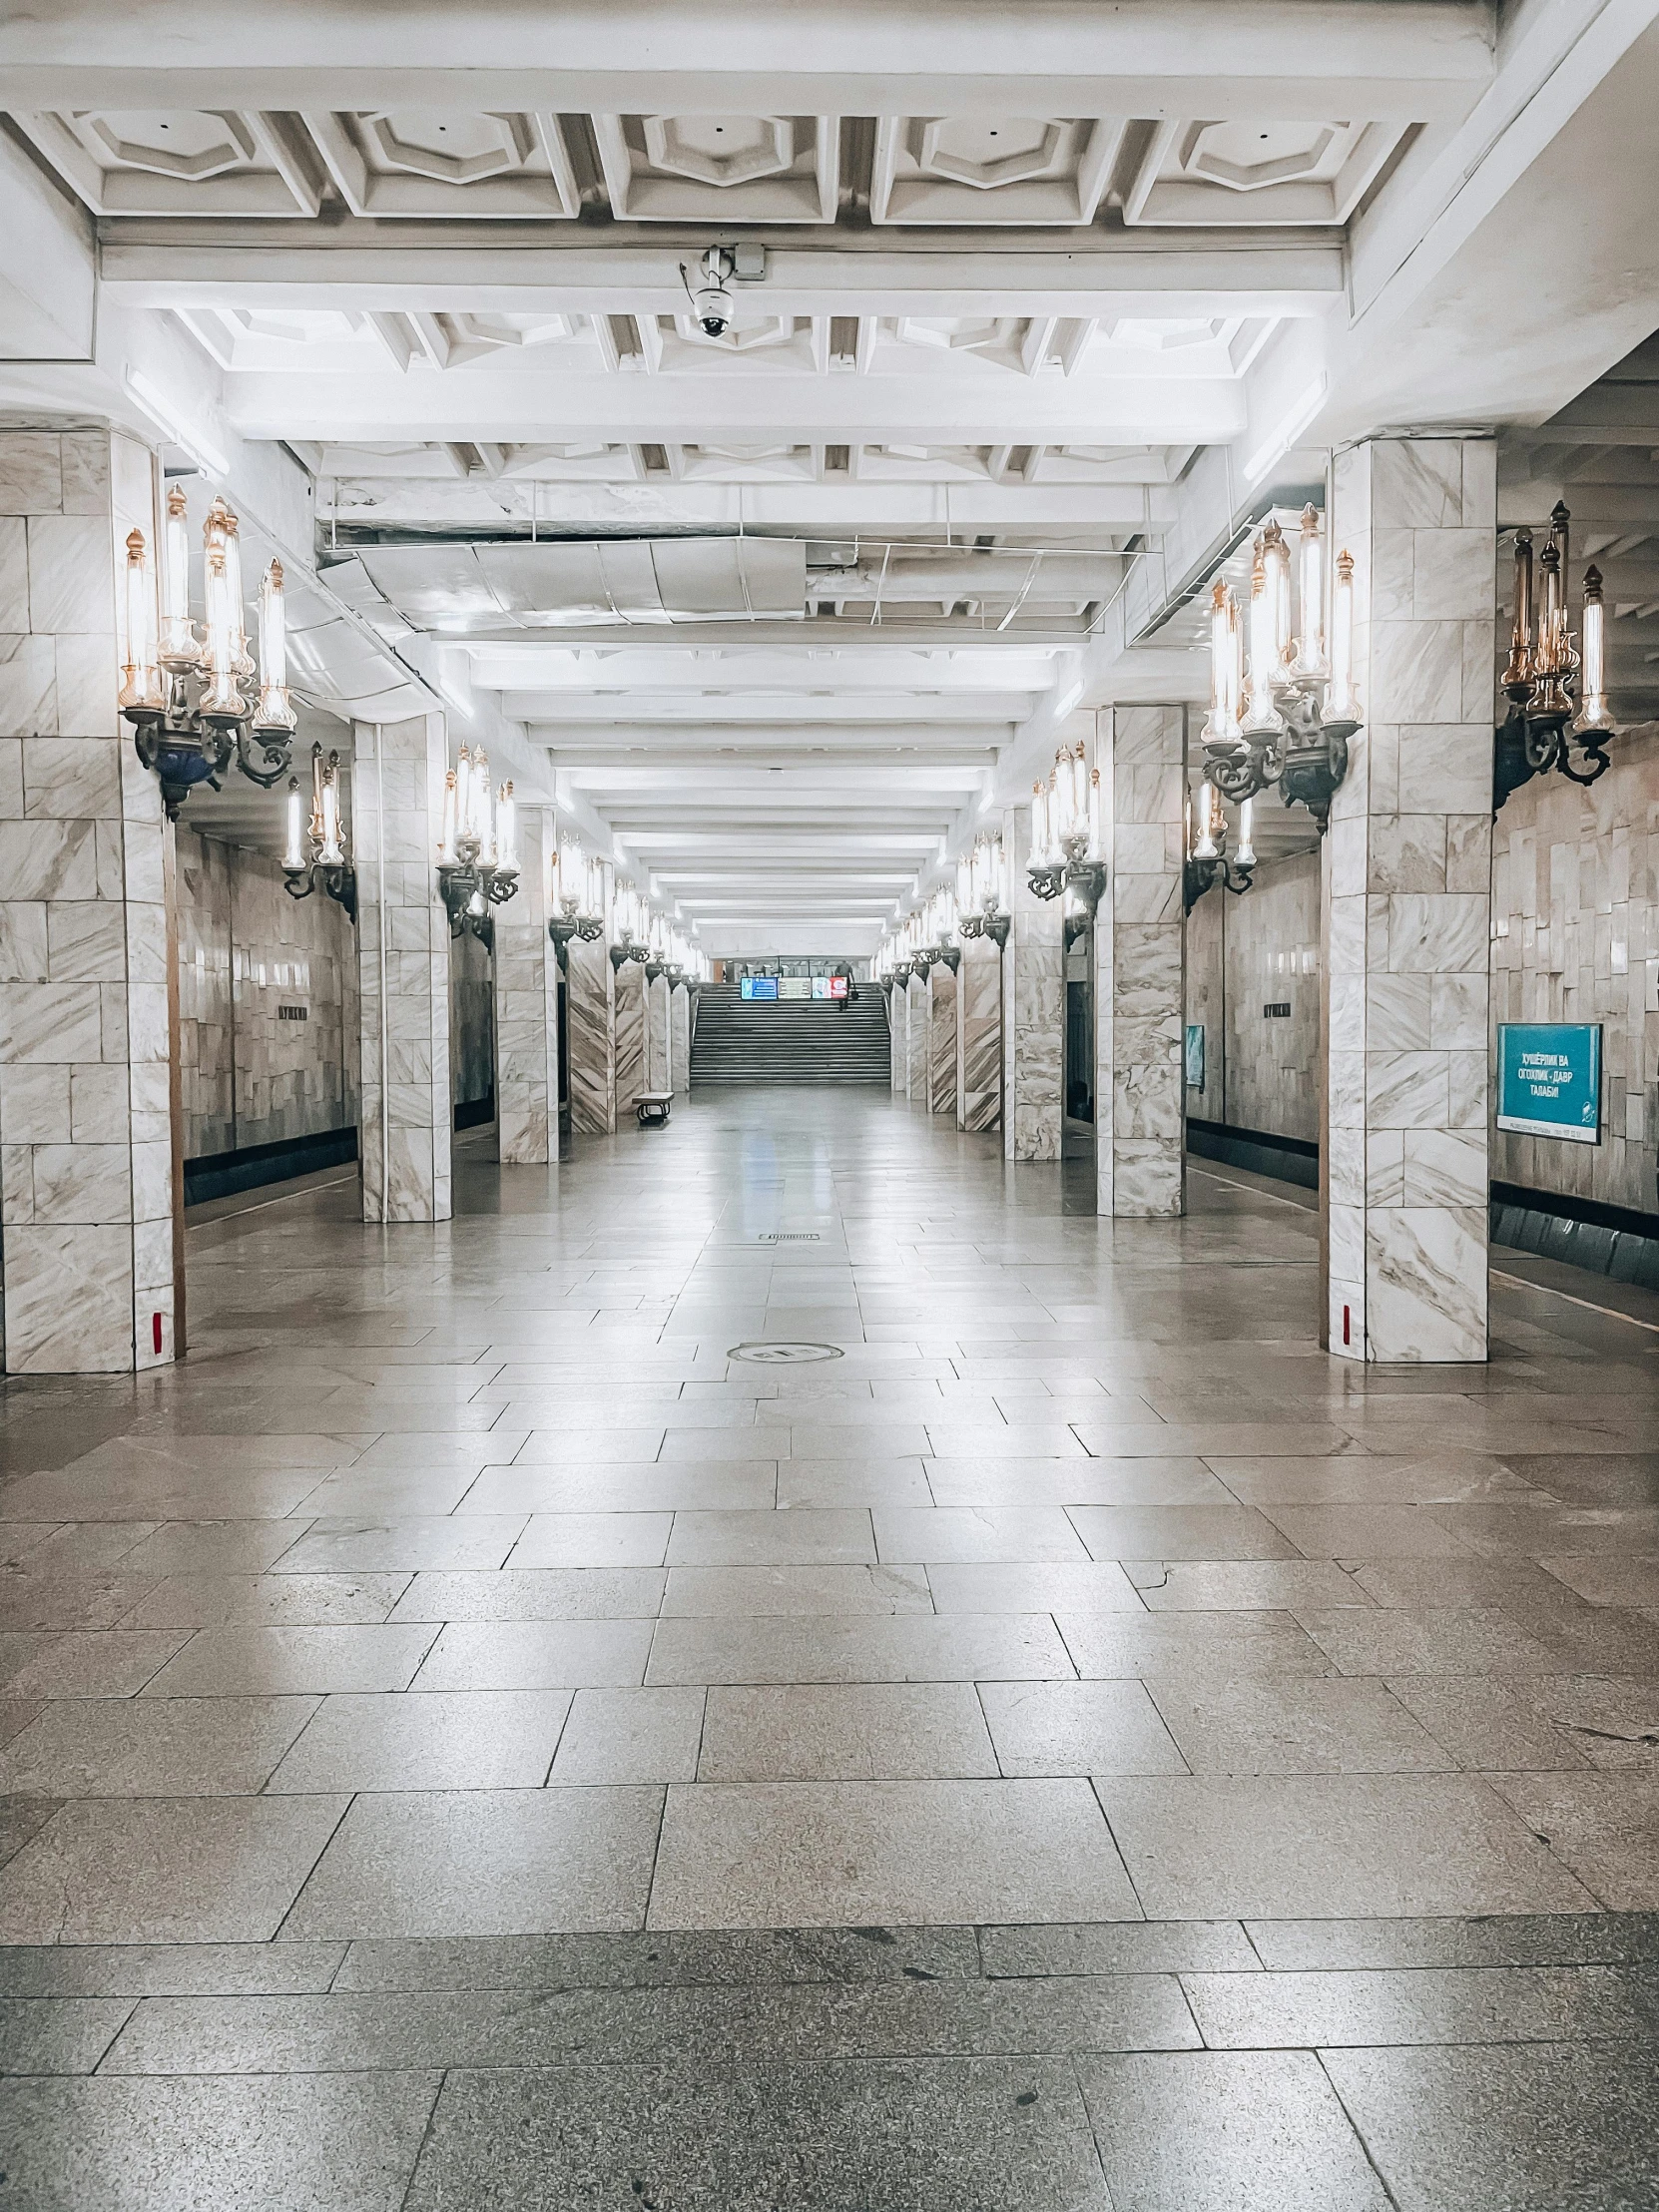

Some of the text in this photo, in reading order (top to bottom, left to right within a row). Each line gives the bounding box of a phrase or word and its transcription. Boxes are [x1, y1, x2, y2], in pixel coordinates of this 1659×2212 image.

[1558, 1055, 1569, 1067] ВА
[1552, 1070, 1573, 1084] ДАВР
[1530, 1084, 1559, 1098] ТАЛАБИ!
